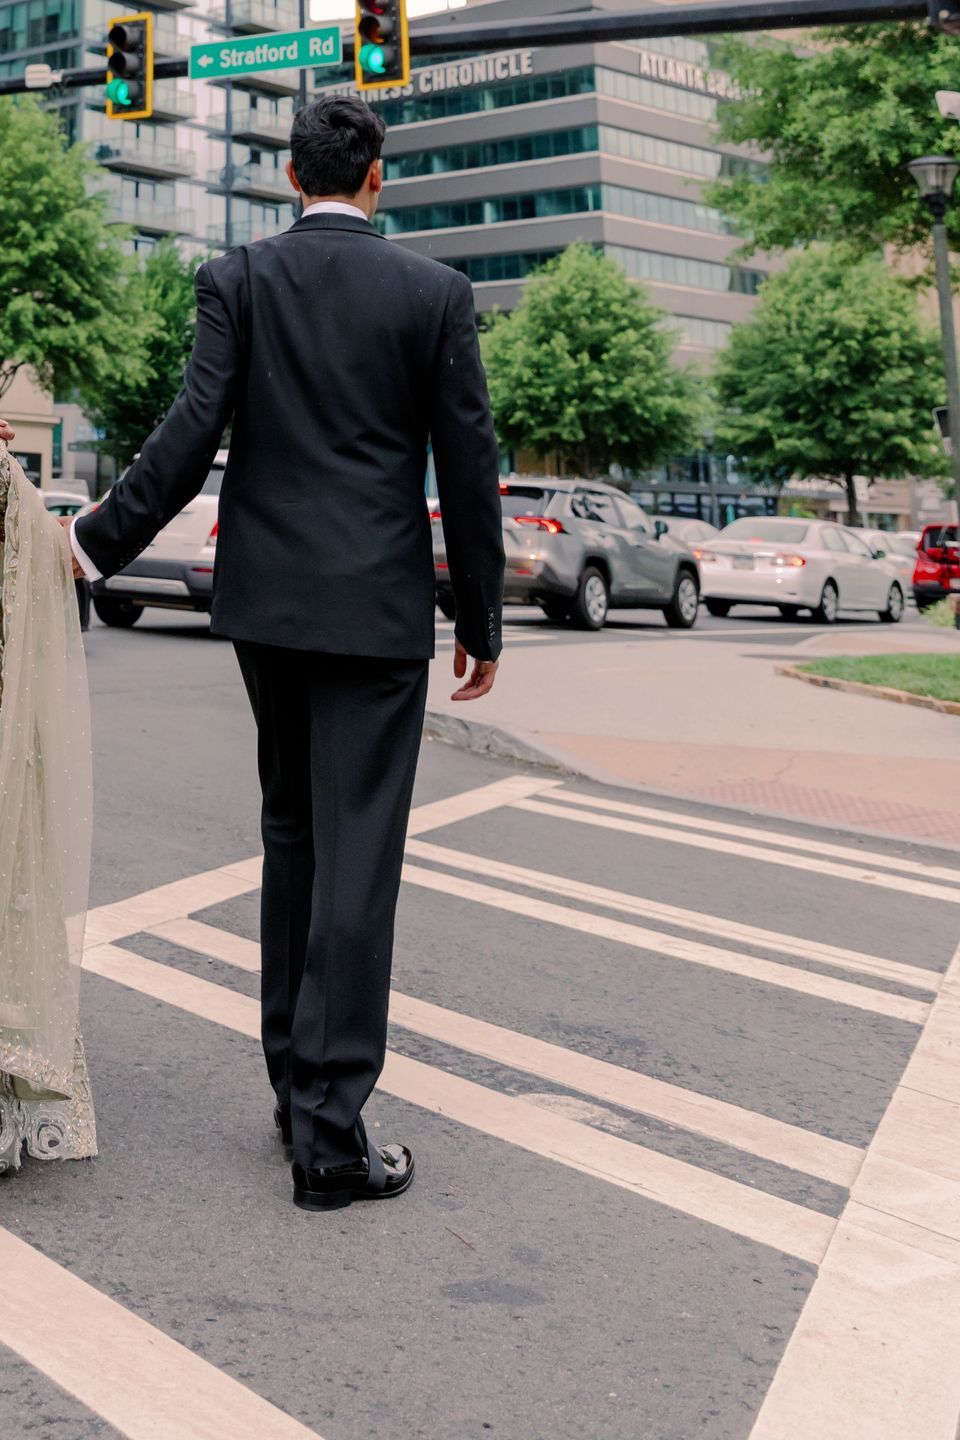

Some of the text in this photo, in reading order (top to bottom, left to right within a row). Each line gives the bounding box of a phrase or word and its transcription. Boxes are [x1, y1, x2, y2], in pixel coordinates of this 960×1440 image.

[219, 35, 334, 69] Stratford Rd
[640, 52, 707, 91] ATLANTA
[326, 50, 533, 104] SINESS CHRONICLE
